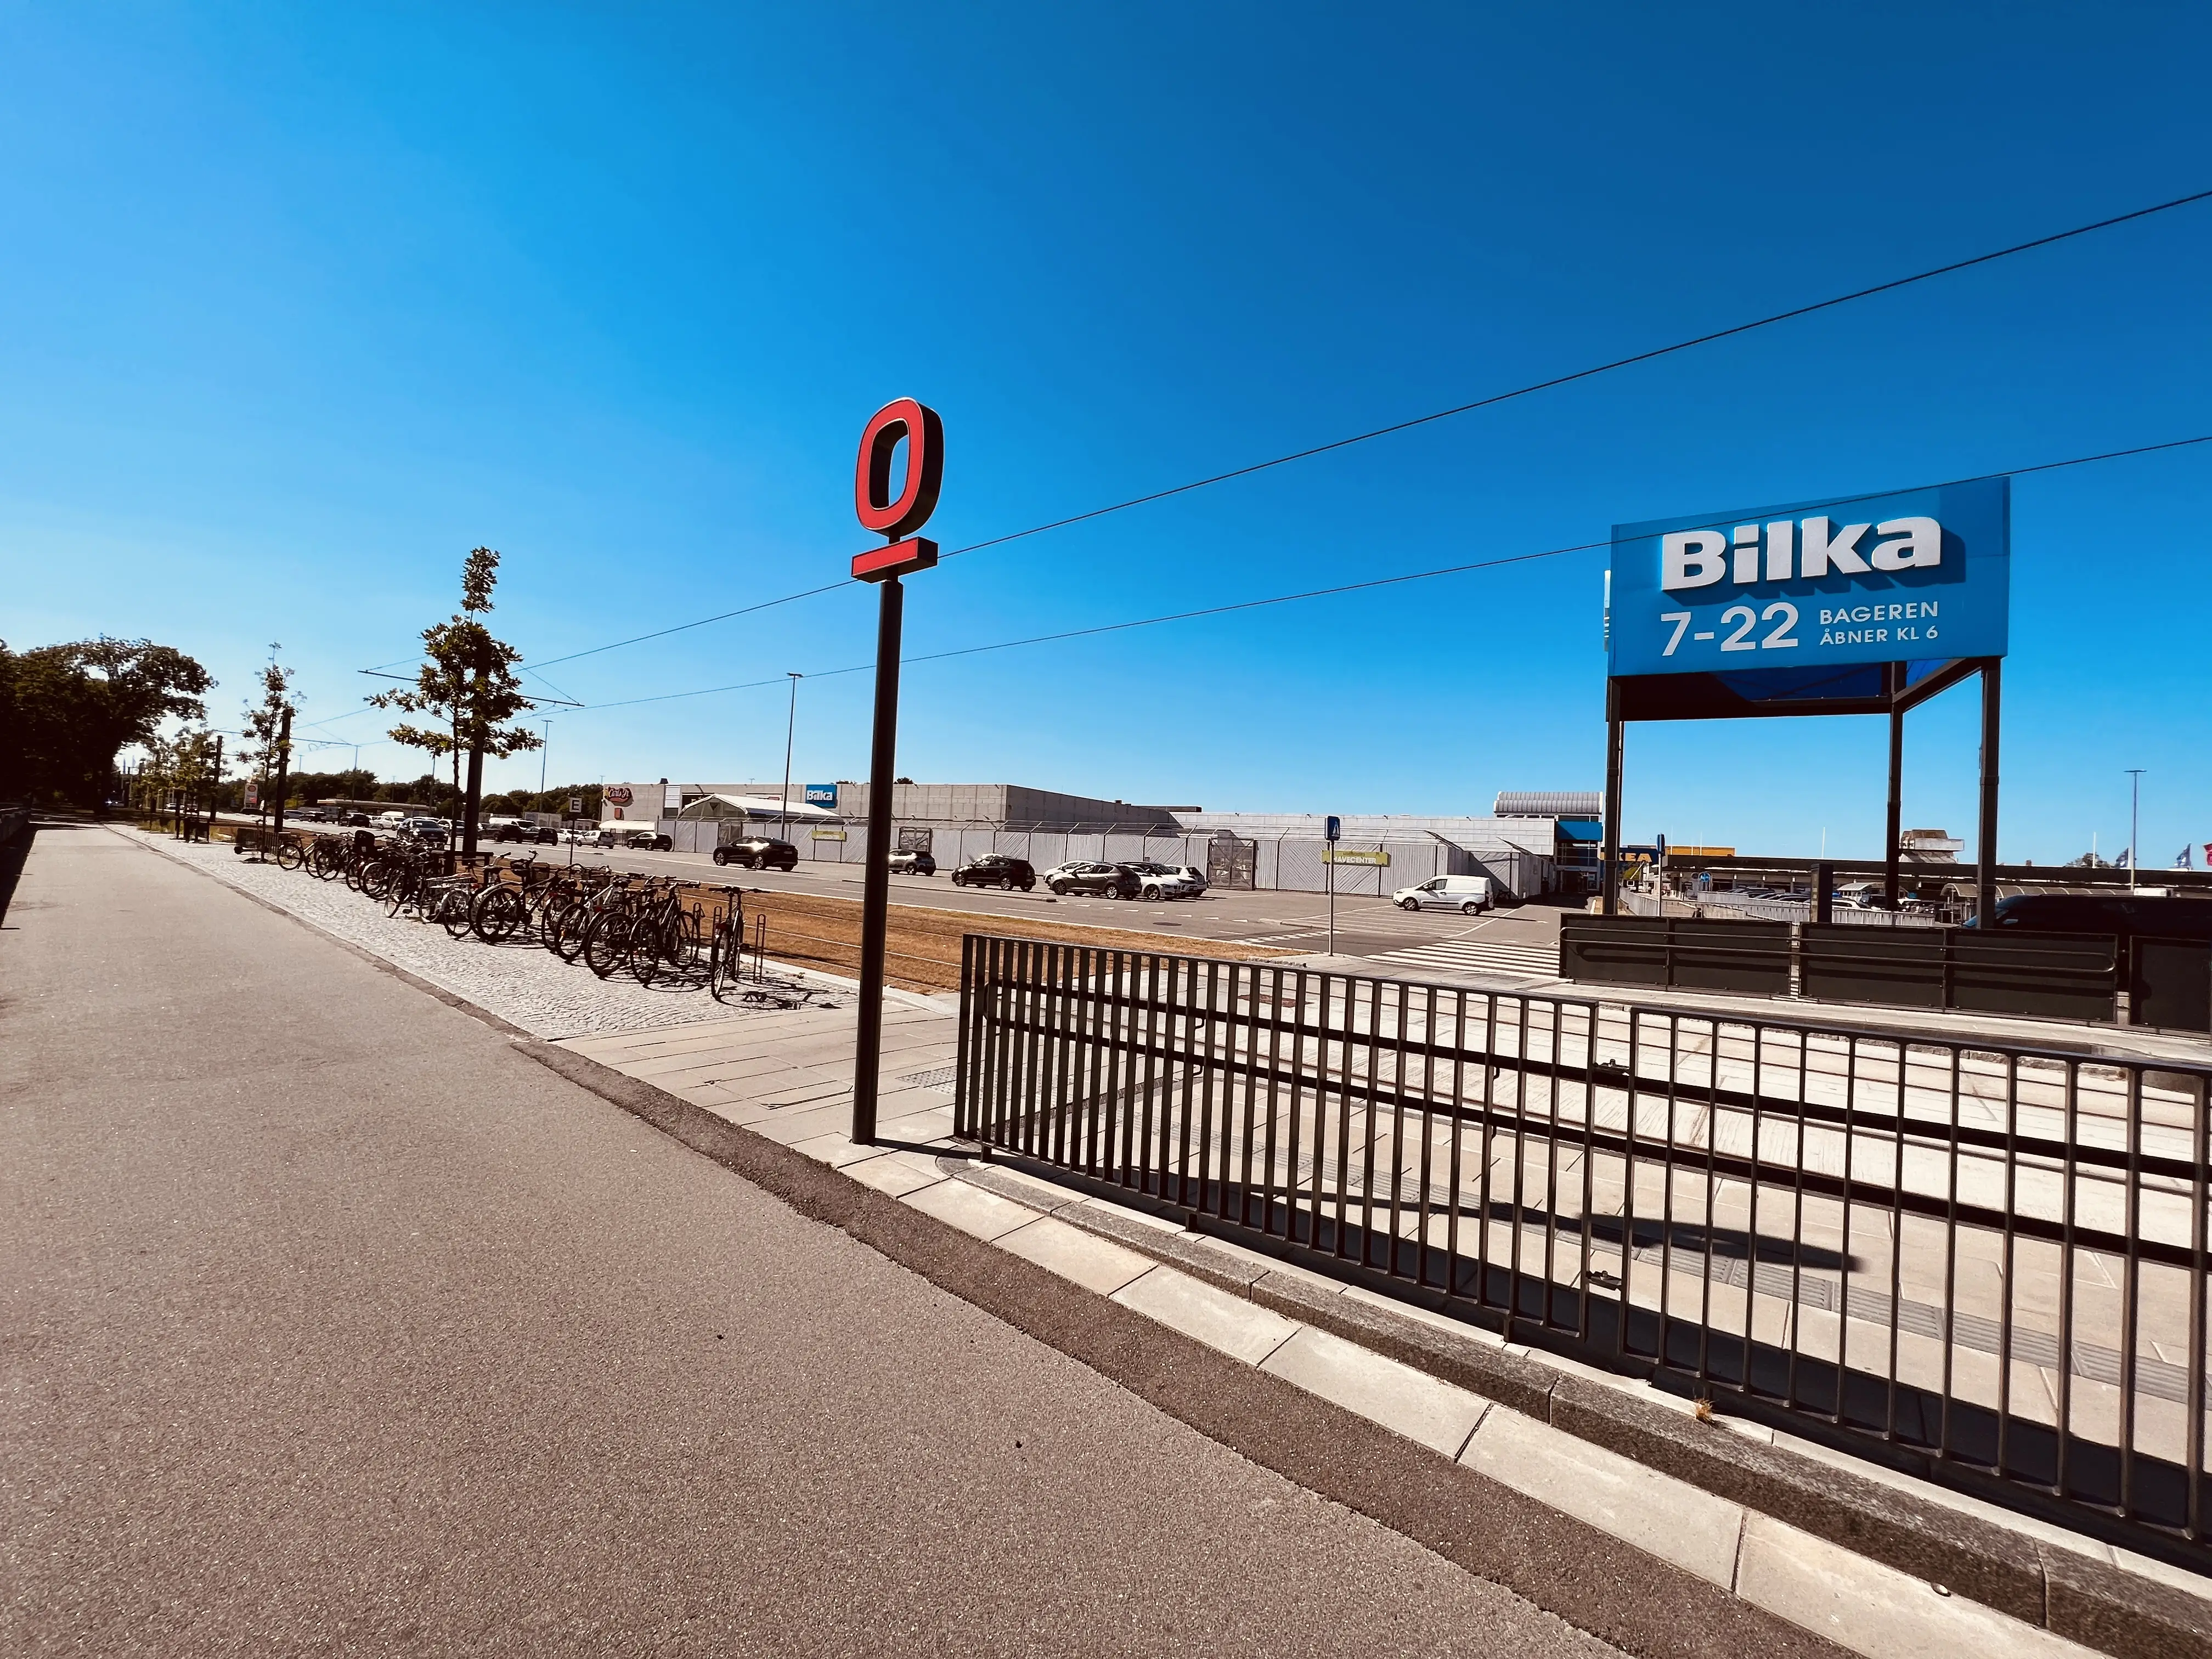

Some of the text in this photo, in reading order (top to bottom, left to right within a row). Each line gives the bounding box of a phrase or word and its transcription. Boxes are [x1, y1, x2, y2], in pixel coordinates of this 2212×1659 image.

[1661, 516, 1942, 591] Bilka
[1820, 601, 1938, 624] BAGEREN
[1661, 602, 1799, 656] 7-22
[1819, 625, 1938, 645] ÅBNER KL 6
[572, 800, 580, 810] E
[806, 790, 833, 800] Bilka
